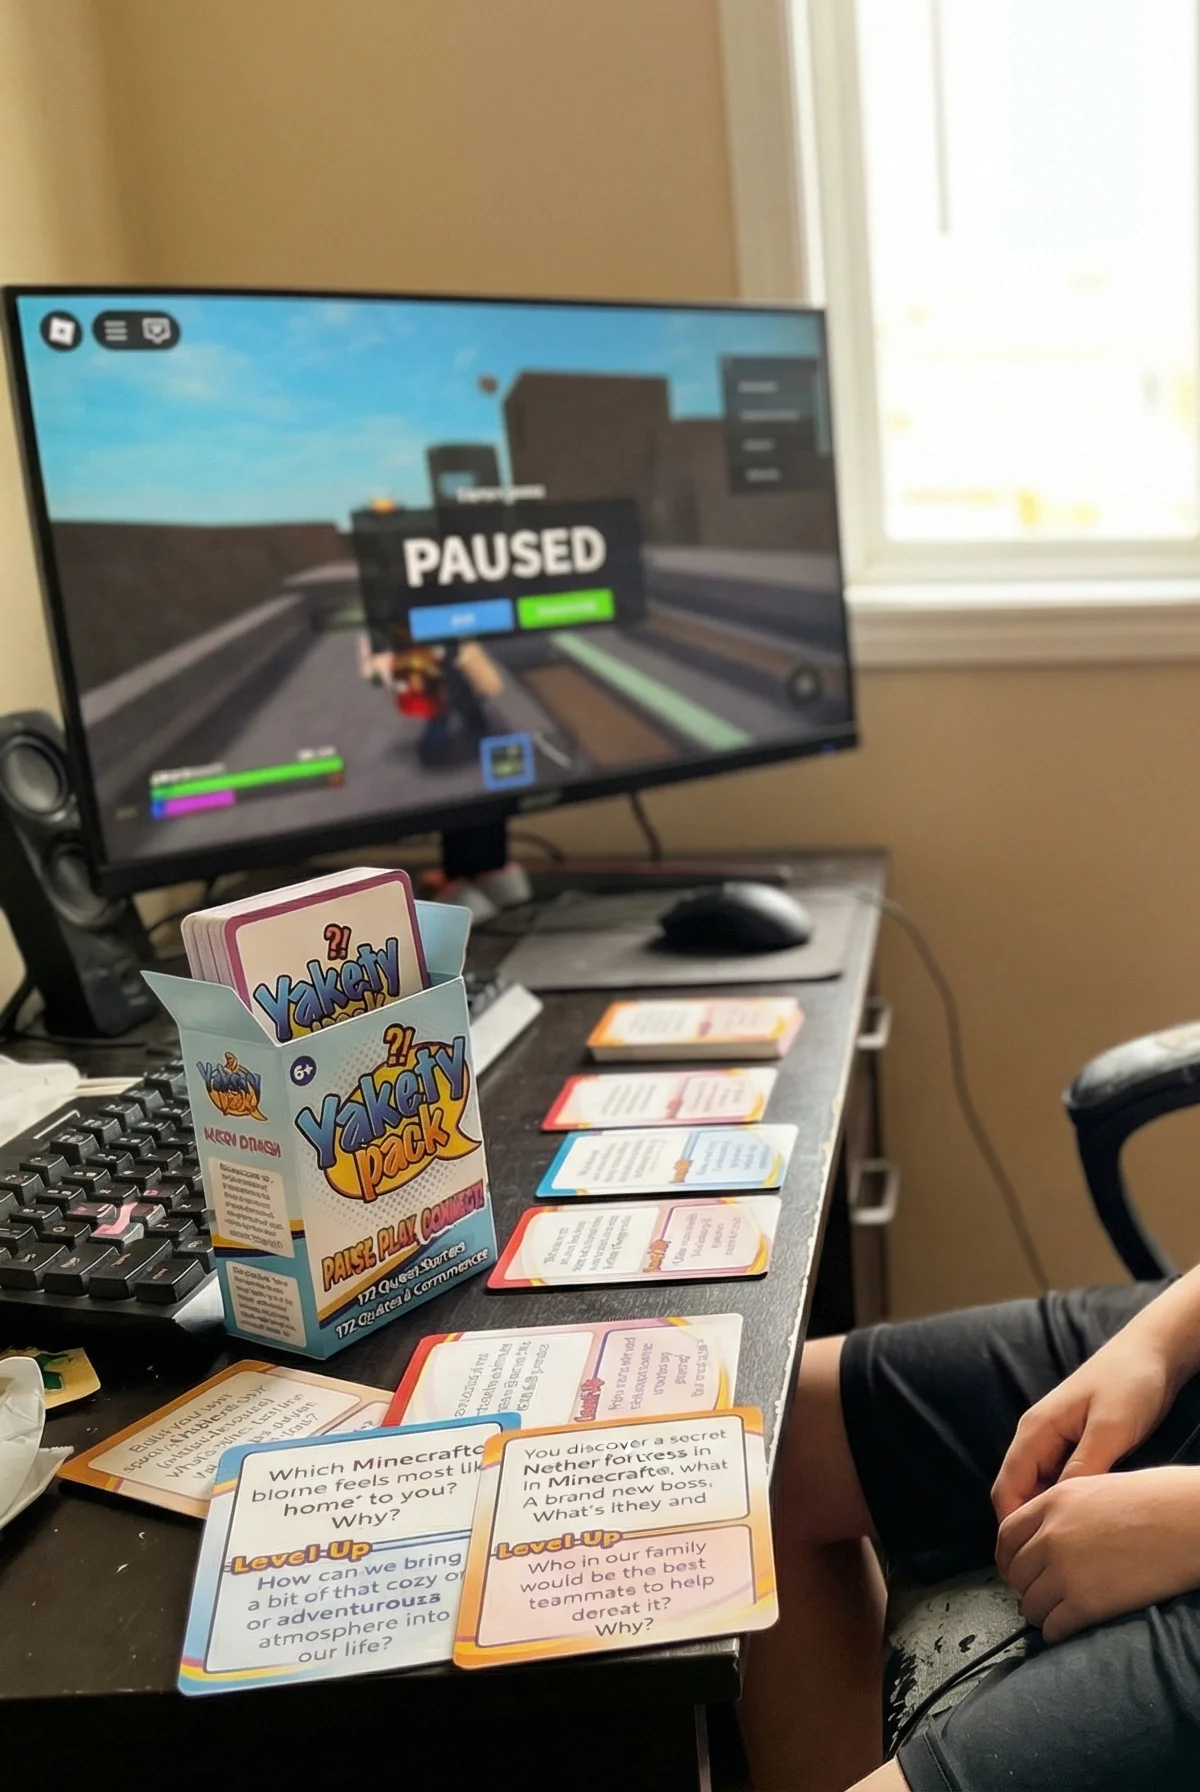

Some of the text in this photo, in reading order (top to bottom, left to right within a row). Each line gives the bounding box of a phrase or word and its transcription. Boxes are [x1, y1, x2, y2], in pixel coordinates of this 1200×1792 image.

[403, 525, 607, 588] PAUSED
[253, 937, 401, 1043] Yakety
[292, 1064, 314, 1081] 6+
[294, 1036, 466, 1171] Yakety
[354, 1102, 451, 1204] pack
[524, 1448, 560, 1460] You
[654, 1437, 664, 1445] a
[268, 1462, 344, 1482] Which
[335, 1474, 390, 1492] feels
[397, 1464, 454, 1483] most
[523, 1457, 600, 1476] Nether
[680, 1459, 729, 1474] what
[370, 1493, 393, 1506] to
[401, 1482, 458, 1504] you?
[523, 1497, 538, 1509] A
[545, 1487, 605, 1505] brand
[612, 1483, 655, 1497] new
[331, 1508, 400, 1529] Why?
[533, 1504, 605, 1524] What's
[668, 1493, 706, 1507] and
[528, 1541, 706, 1574] Who in our family
[257, 1553, 462, 1591] How can we bring
[520, 1558, 706, 1593] would be the best
[643, 1581, 664, 1594] to
[670, 1574, 715, 1591] help
[247, 1600, 260, 1611] a
[268, 1592, 298, 1609] bit
[304, 1587, 329, 1603] of
[334, 1582, 380, 1599] that
[386, 1574, 438, 1591] cozy
[647, 1596, 671, 1612] it?
[246, 1618, 272, 1631] or
[259, 1610, 450, 1649] atmosphere into
[595, 1617, 654, 1637] Why?
[298, 1636, 393, 1663] our life?
